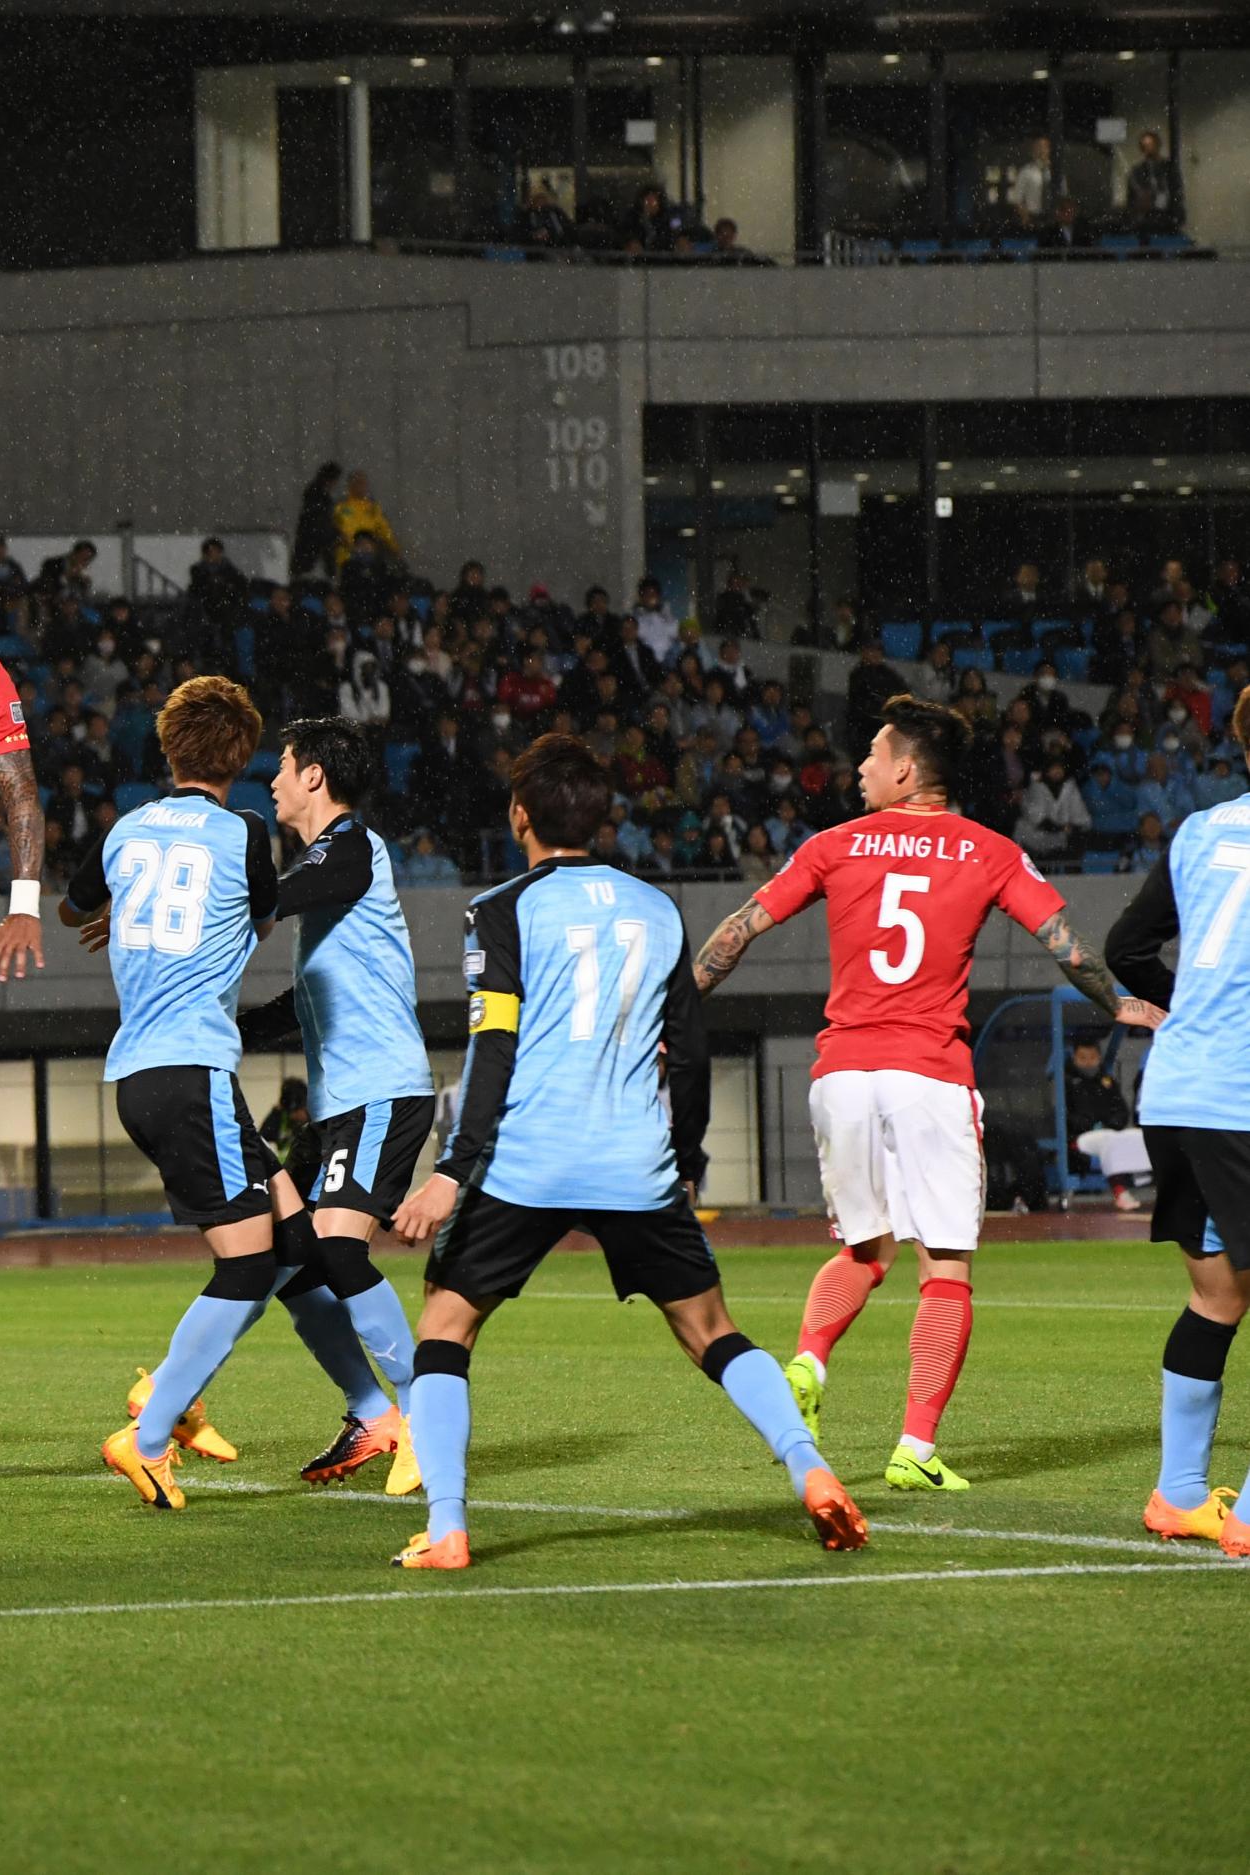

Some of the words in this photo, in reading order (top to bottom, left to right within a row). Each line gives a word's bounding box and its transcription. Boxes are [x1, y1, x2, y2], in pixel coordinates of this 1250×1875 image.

[544, 344, 606, 381] 108
[547, 416, 608, 451] 109
[548, 453, 609, 492] 110
[848, 833, 932, 858] ZHANG
[118, 838, 213, 956] 28
[582, 880, 616, 906] YU
[869, 872, 931, 985] 5
[566, 919, 647, 1046] 11
[324, 1148, 348, 1193] 5
